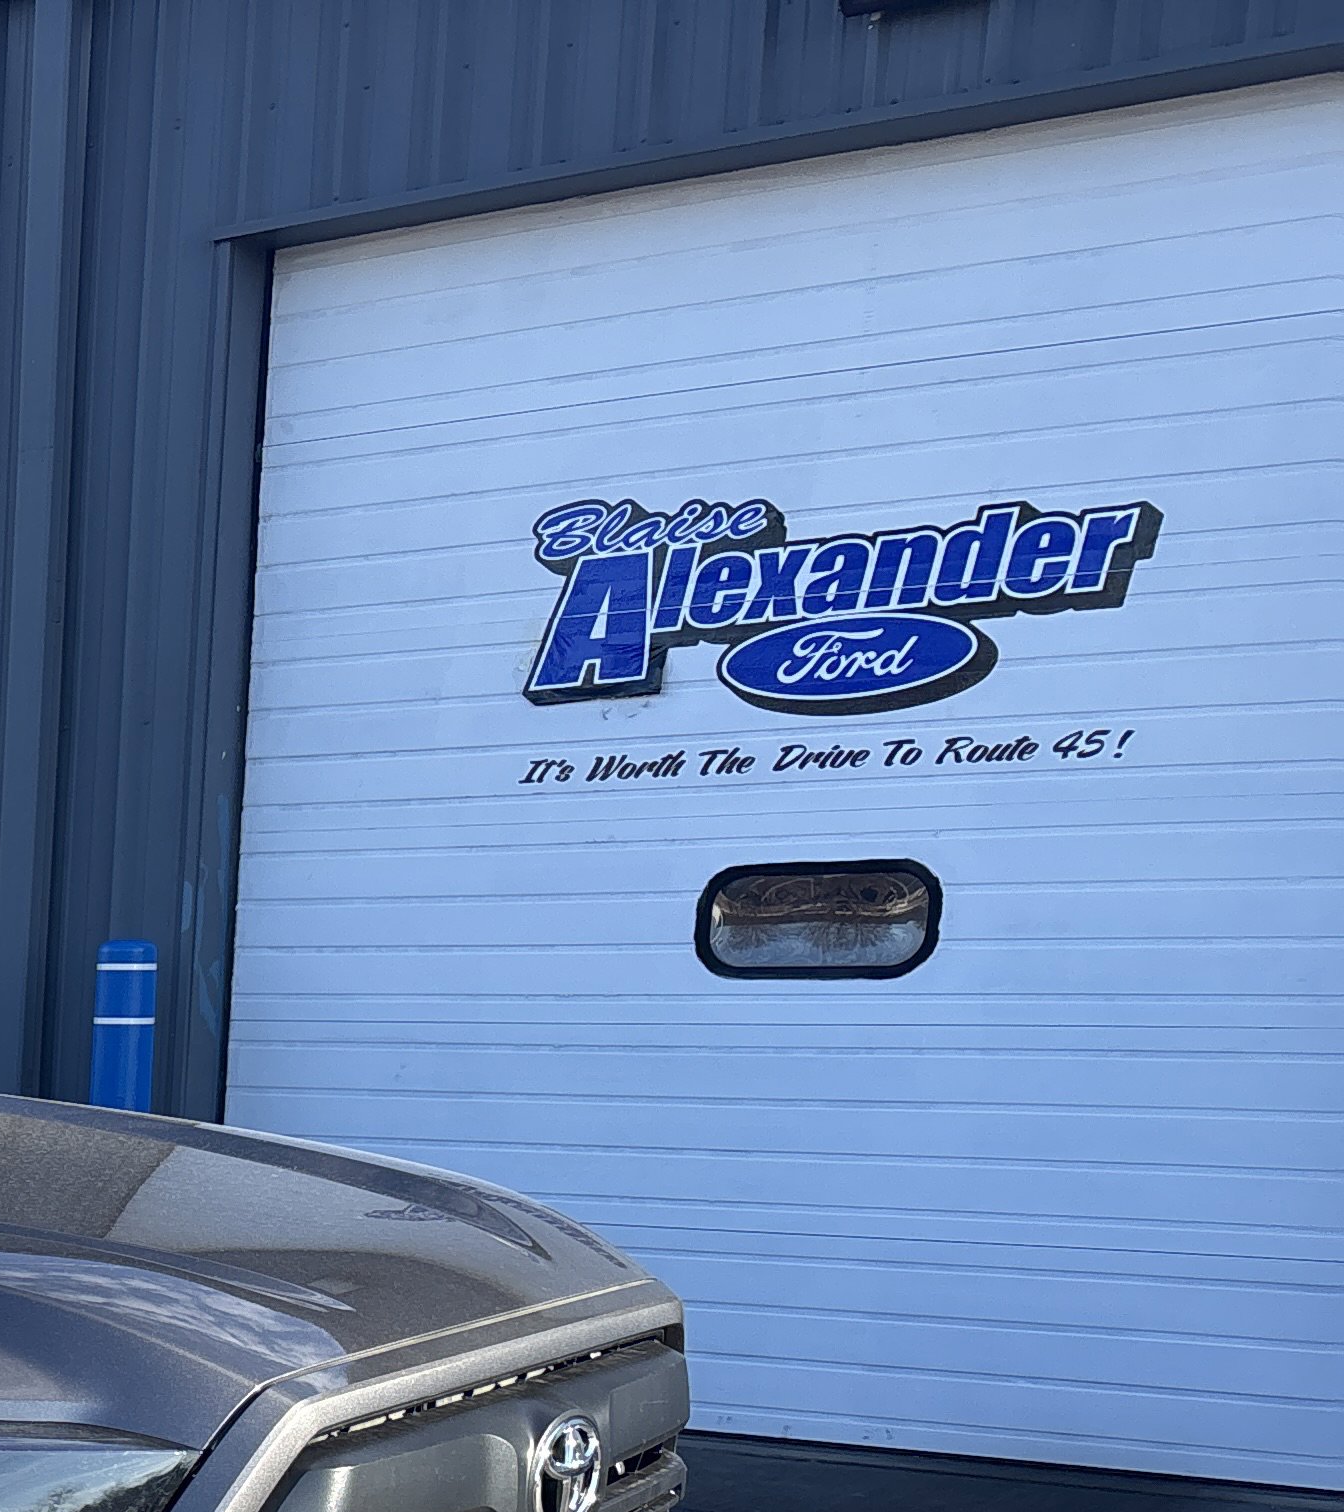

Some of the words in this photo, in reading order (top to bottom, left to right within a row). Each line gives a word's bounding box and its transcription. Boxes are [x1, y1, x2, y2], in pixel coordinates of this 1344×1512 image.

[533, 498, 772, 562] Blaise
[525, 502, 1148, 694] Alexander
[776, 627, 920, 686] Ford
[517, 757, 576, 785] It's
[584, 748, 688, 783] Worth
[697, 746, 757, 777] The
[770, 743, 871, 772] Drive
[882, 738, 923, 767] To
[934, 735, 1041, 766] Route
